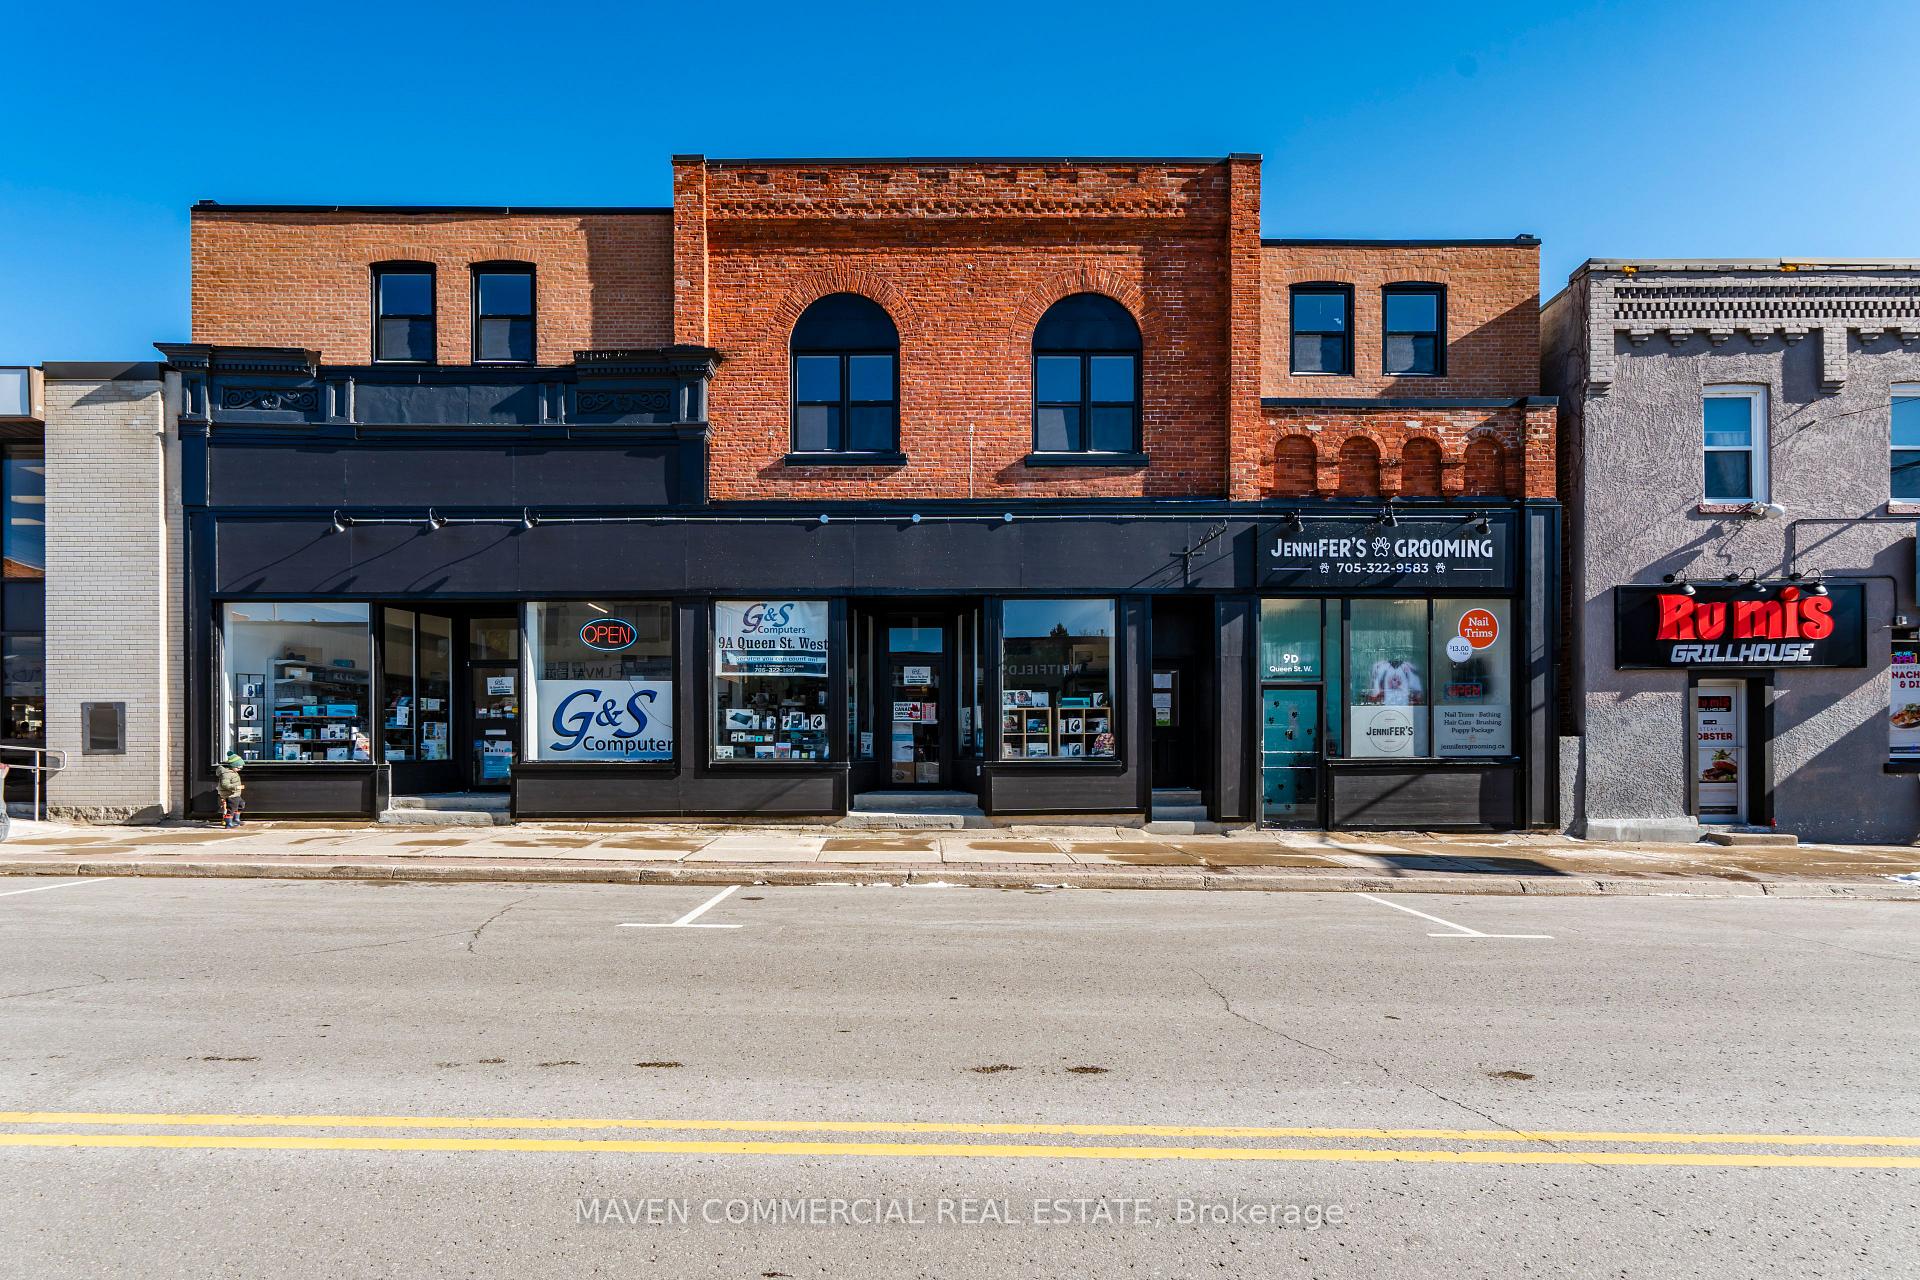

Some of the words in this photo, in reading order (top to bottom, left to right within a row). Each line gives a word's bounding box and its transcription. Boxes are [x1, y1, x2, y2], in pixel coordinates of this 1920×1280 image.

[1271, 537, 1367, 558] JENNIFER'S
[1394, 539, 1493, 558] GROOMING
[1336, 563, 1429, 573] 705-322-9583
[741, 603, 795, 634] G&S
[1468, 617, 1489, 627] Nail
[583, 625, 631, 645] OPEN
[757, 625, 806, 635] Computers
[1465, 628, 1493, 638] Trims
[718, 636, 734, 649] 9A
[737, 636, 776, 651] Queen
[779, 636, 795, 649] St.
[799, 637, 829, 650] West
[1671, 643, 1814, 663] GRILLHOUSE
[1283, 654, 1299, 664] 9D
[1900, 680, 1906, 688] &
[549, 689, 658, 751] G&S
[1366, 726, 1414, 736] JENNIFER'S
[1697, 732, 1733, 740] OBSTER
